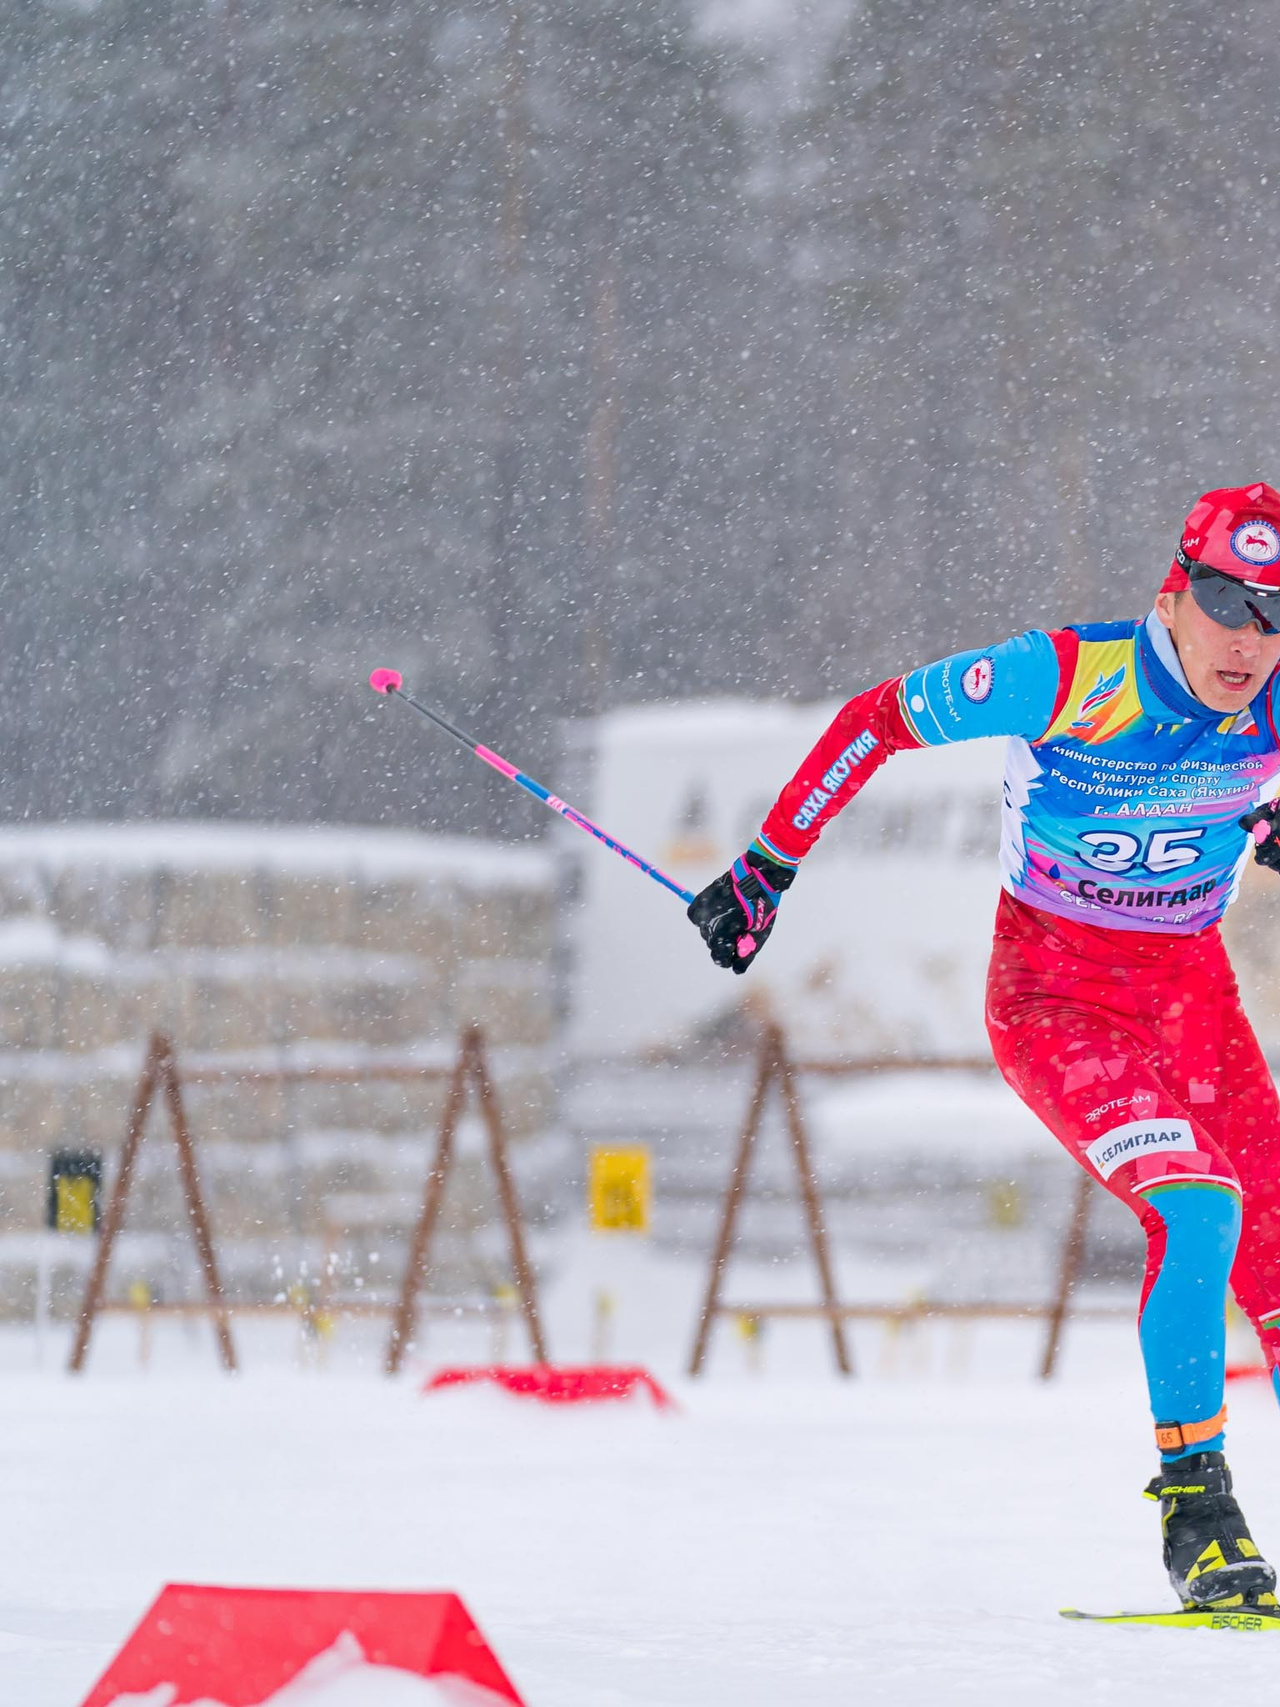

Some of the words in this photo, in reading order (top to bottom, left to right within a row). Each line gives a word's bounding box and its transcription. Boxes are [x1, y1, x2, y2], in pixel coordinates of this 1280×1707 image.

[793, 787, 833, 830] САХА
[821, 728, 879, 793] ЯКУТИЯ
[1092, 770, 1155, 786] культуре
[1159, 775, 1168, 783] и
[1171, 774, 1221, 786] спорту
[1160, 762, 1177, 771] по
[1180, 759, 1263, 773] физической
[1050, 768, 1143, 798] Республики
[1147, 785, 1187, 798] Саха
[1191, 782, 1255, 799] (Якутия)
[1093, 805, 1109, 816] г.
[1116, 802, 1194, 818] АЛДАН
[1074, 827, 1208, 875] 35
[1078, 879, 1217, 908] Селигдар
[1085, 1094, 1151, 1124] PROTEAM
[1101, 1131, 1182, 1163] СЕЛИГДАР
[1161, 1431, 1174, 1444] 65
[1211, 1615, 1262, 1632] FISCHER
